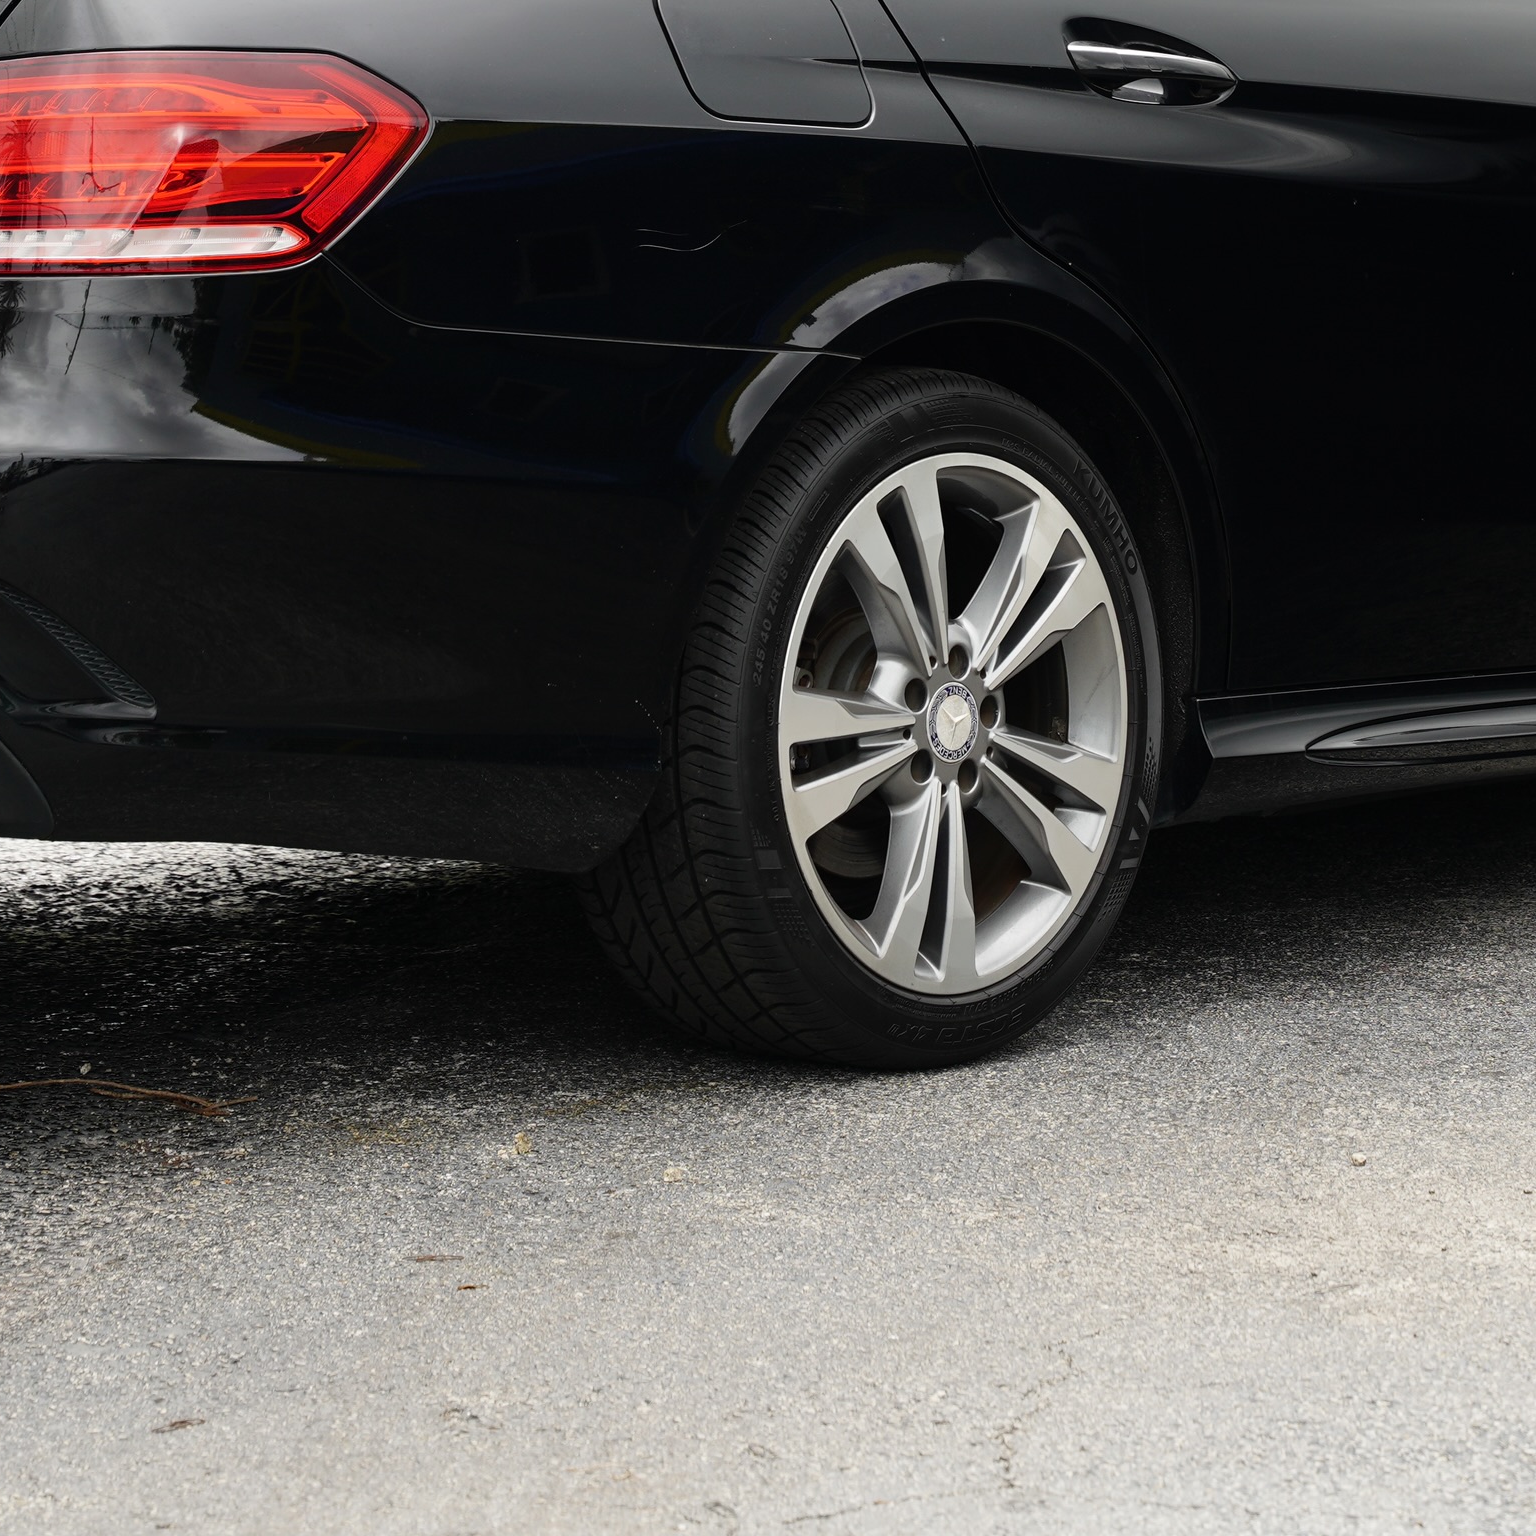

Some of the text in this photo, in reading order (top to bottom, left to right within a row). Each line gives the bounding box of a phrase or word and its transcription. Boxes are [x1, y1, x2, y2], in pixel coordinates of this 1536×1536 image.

[1073, 459, 1138, 575] KUMHO
[948, 686, 968, 699] BENZ
[933, 737, 968, 760] MERCEDES
